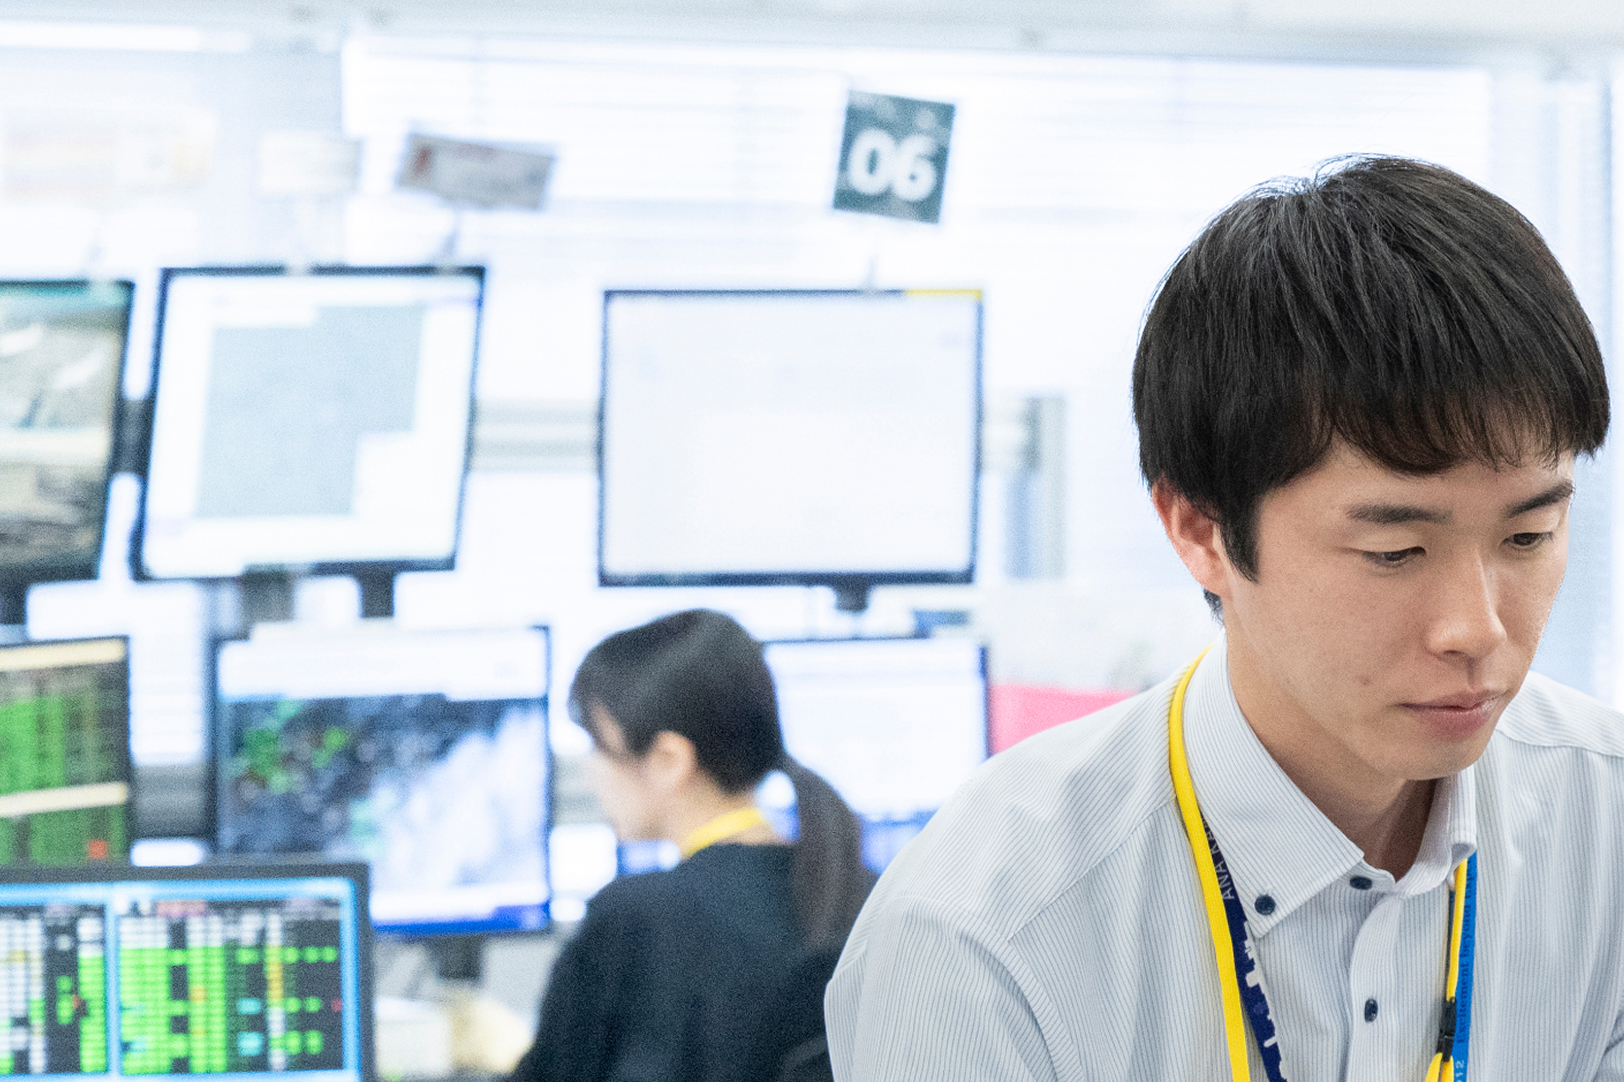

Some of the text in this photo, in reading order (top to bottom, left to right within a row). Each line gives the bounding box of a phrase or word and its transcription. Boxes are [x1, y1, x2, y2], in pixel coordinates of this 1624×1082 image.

[850, 129, 938, 202] 06
[1214, 861, 1235, 900] ANA
[1457, 963, 1470, 1043] Excitement
